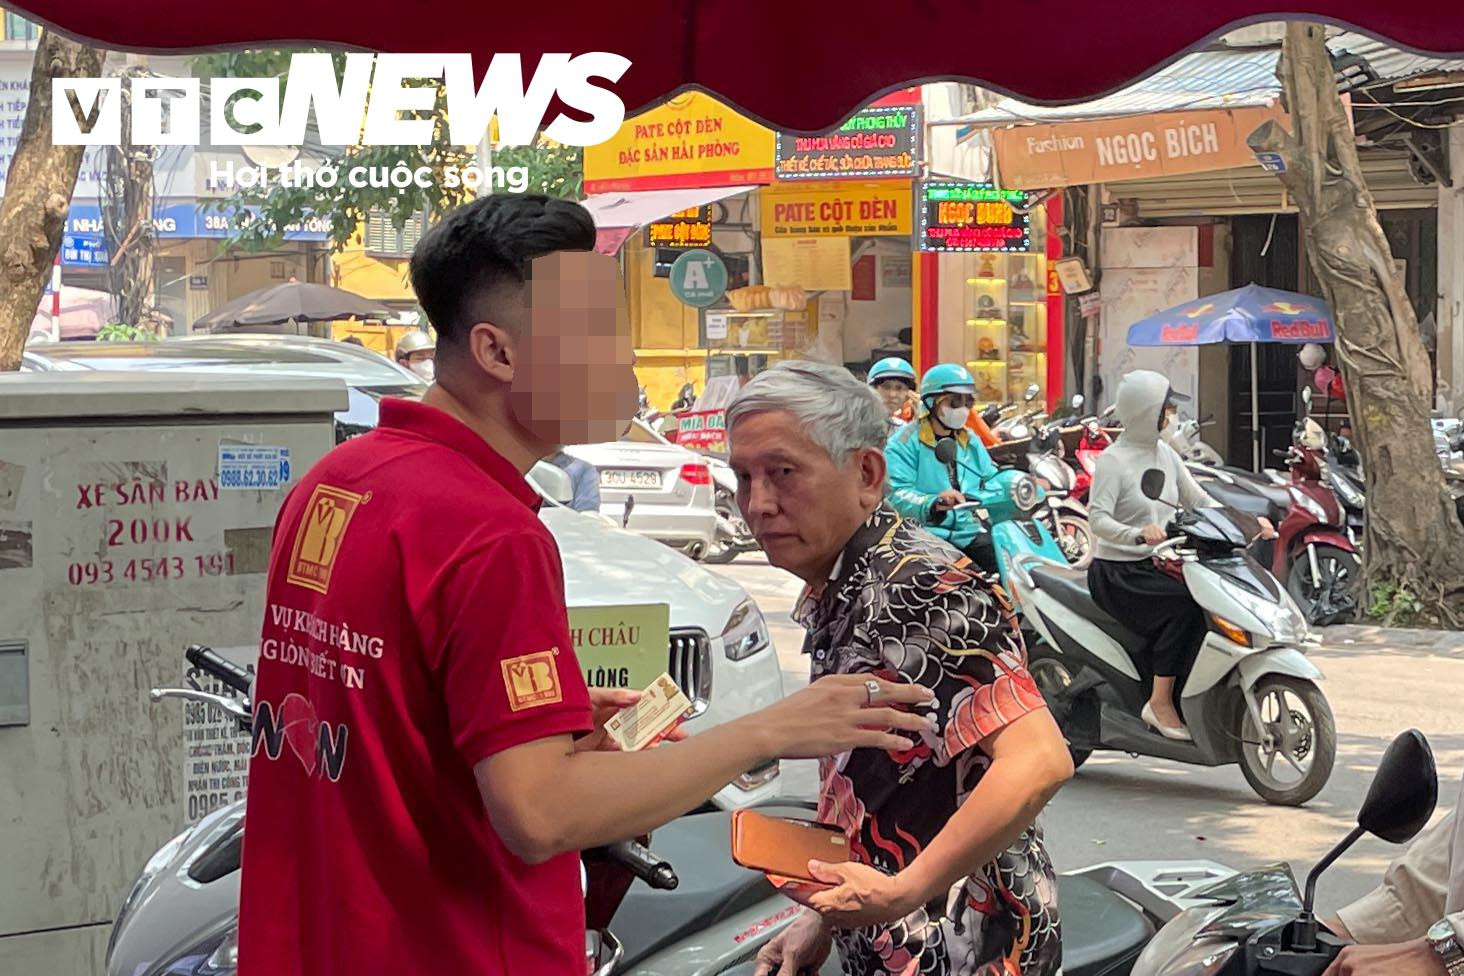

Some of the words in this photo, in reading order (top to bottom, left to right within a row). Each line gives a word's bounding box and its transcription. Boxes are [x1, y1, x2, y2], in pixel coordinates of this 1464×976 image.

[635, 122, 665, 140] PATE
[667, 118, 692, 138] CỘT
[619, 148, 641, 167] ĐẶC
[644, 145, 669, 162] SẢN
[672, 140, 694, 160] HẢI
[698, 140, 740, 158] PHÒNG
[1096, 131, 1158, 169] NGỌC
[1164, 120, 1219, 159] BÍCH
[774, 200, 815, 223] PATE
[819, 197, 854, 227] CỘT
[859, 198, 897, 221] ĐÈN
[77, 482, 107, 509] XE
[115, 475, 165, 506] SÂN
[175, 479, 219, 503] BAY
[108, 515, 194, 547] 200K
[68, 560, 114, 585] 093
[124, 556, 185, 582] 4543
[271, 604, 293, 633] VỤ
[588, 620, 641, 648] CHÂU
[587, 665, 629, 688] LÒNG
